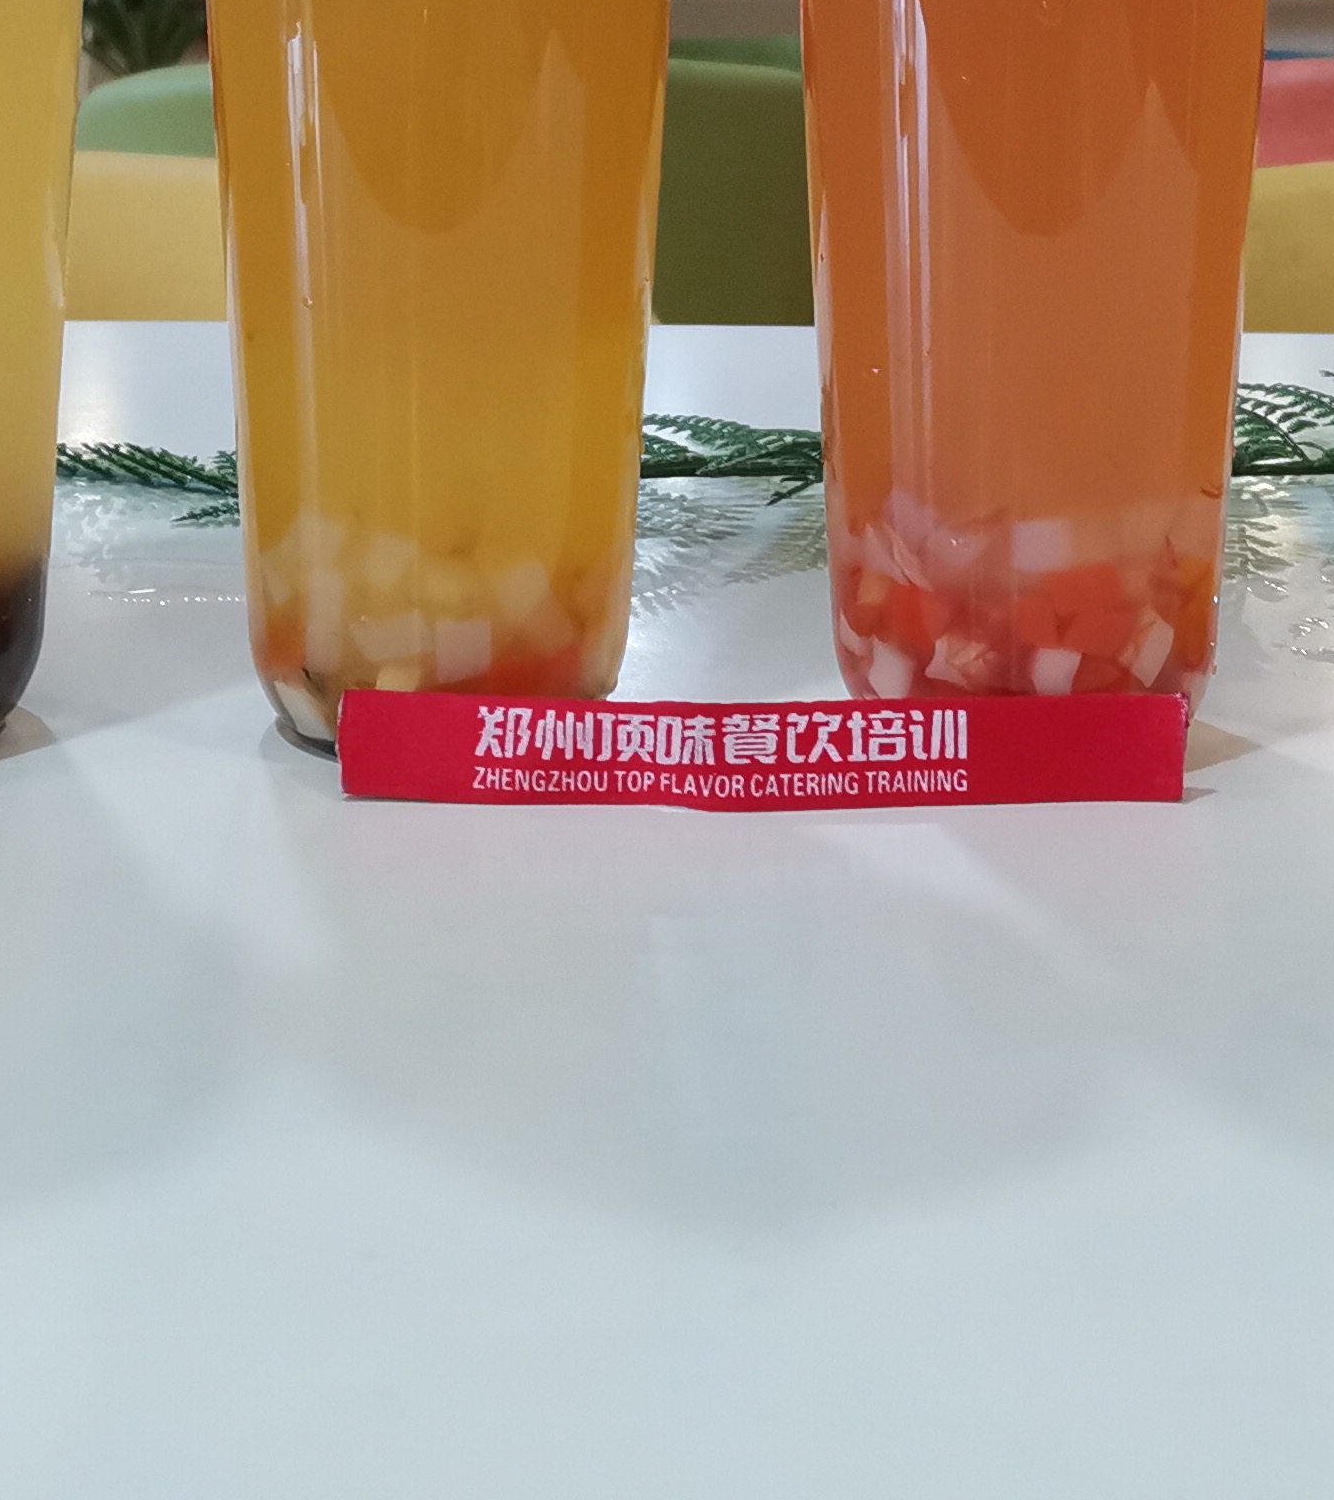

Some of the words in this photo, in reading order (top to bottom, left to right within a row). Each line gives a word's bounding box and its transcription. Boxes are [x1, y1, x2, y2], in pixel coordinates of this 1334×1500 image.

[474, 705, 967, 765] 郑州顶味餐饮培训
[472, 766, 608, 793] ZHENGZHOU
[614, 770, 655, 793] TOP
[659, 772, 745, 798] FLAVOR
[750, 771, 859, 797] CATERING
[865, 768, 968, 794] TRAINING
